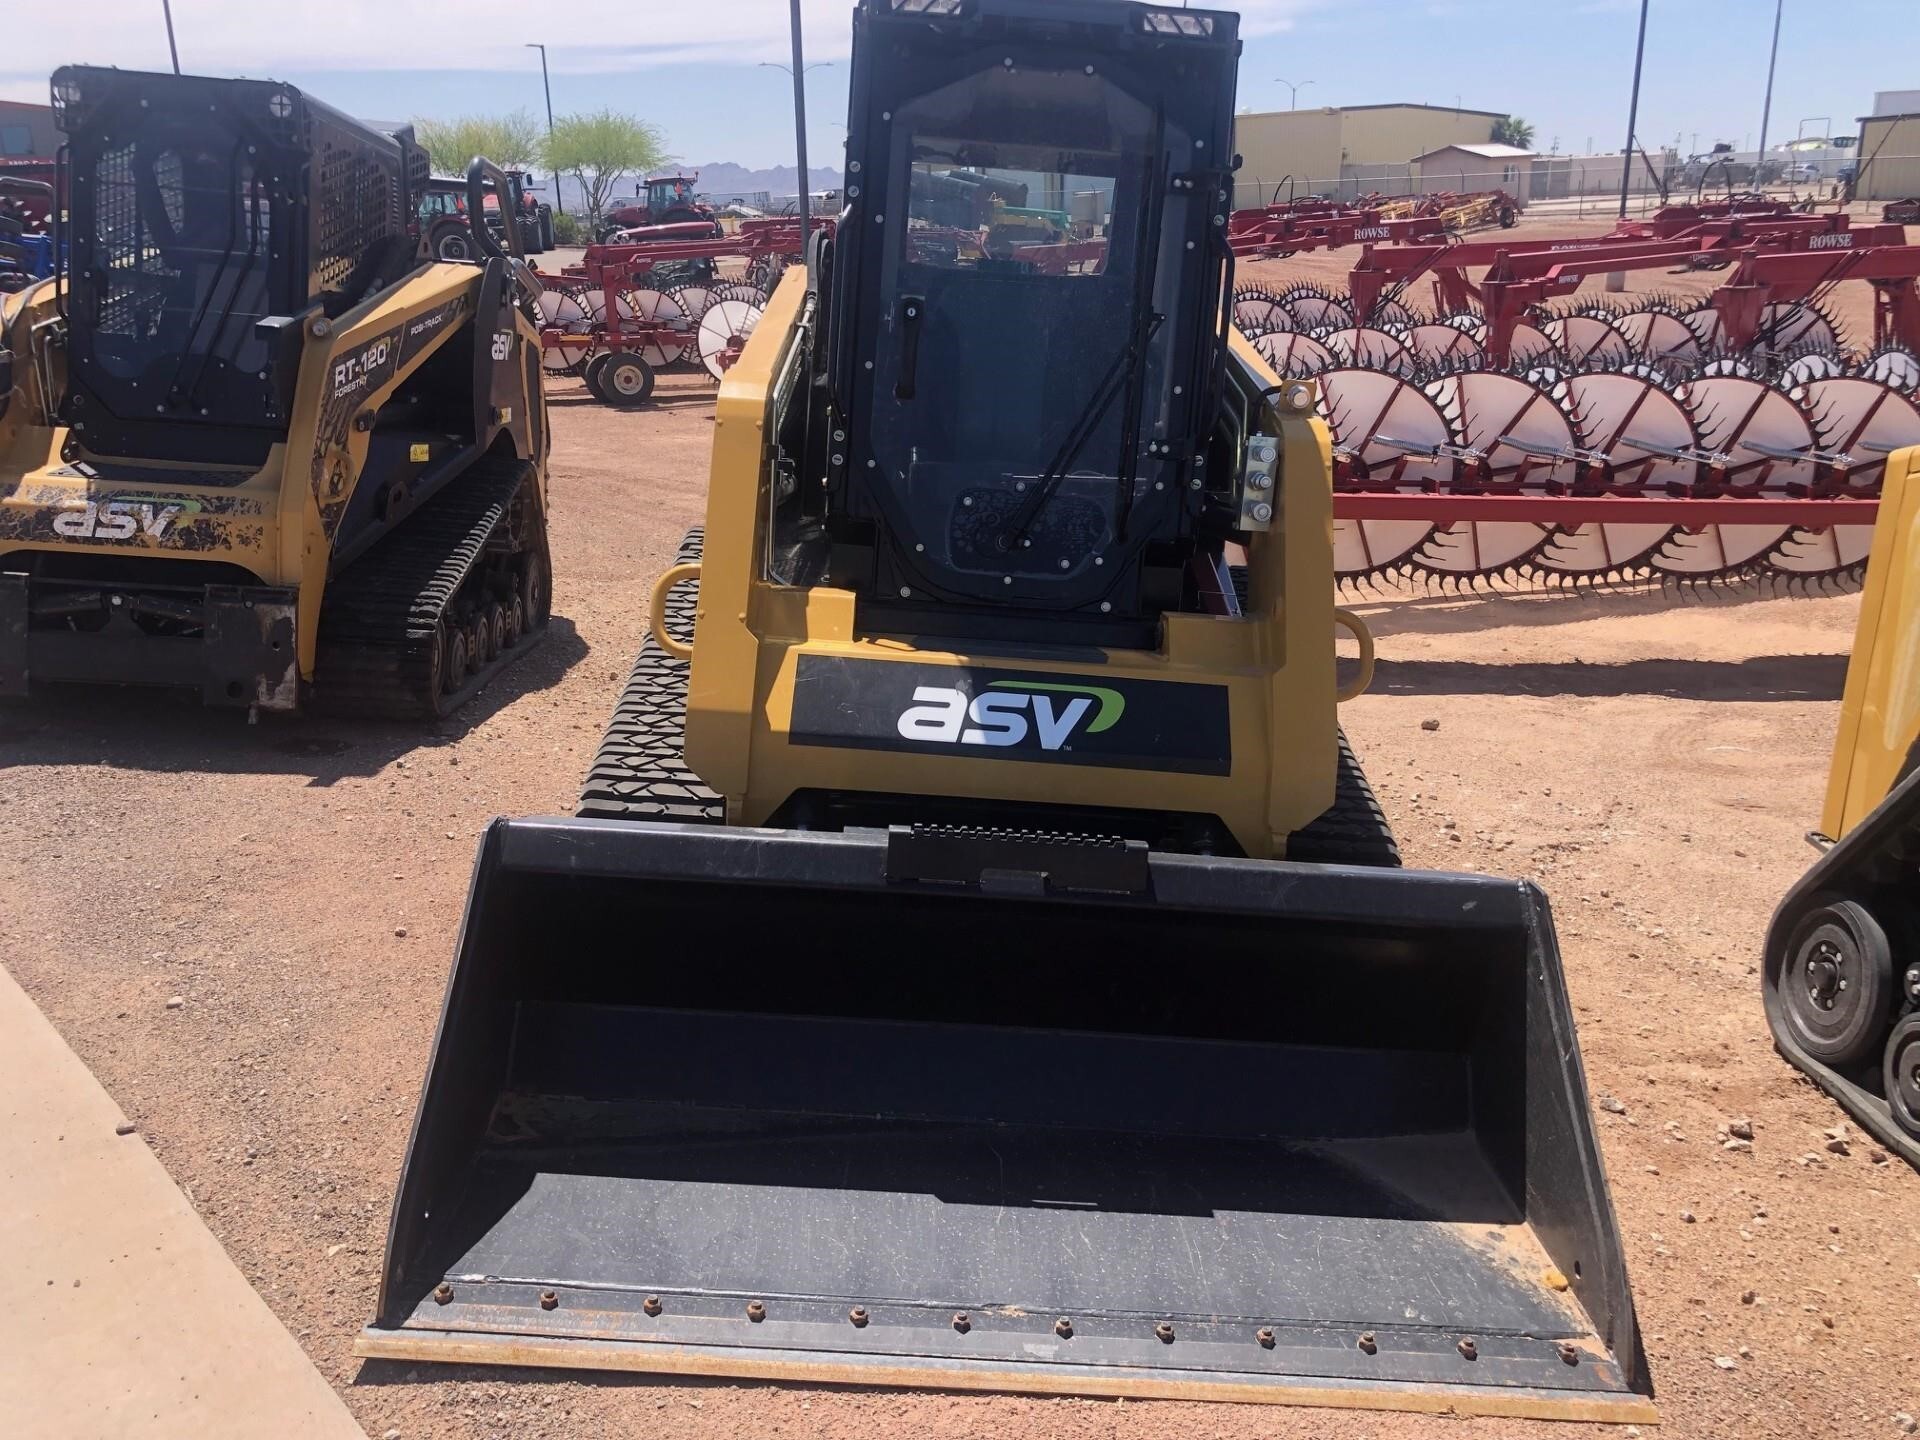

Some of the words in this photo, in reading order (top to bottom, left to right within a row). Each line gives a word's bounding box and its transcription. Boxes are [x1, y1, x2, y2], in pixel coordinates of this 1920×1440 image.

[1354, 226, 1390, 240] ROWSE
[1809, 233, 1852, 249] ROWSE
[410, 314, 443, 337] POSI-TRACK
[334, 343, 387, 388] RT-120
[334, 373, 368, 400] FORESTRY
[53, 499, 181, 541] asv
[897, 686, 1093, 751] asv
